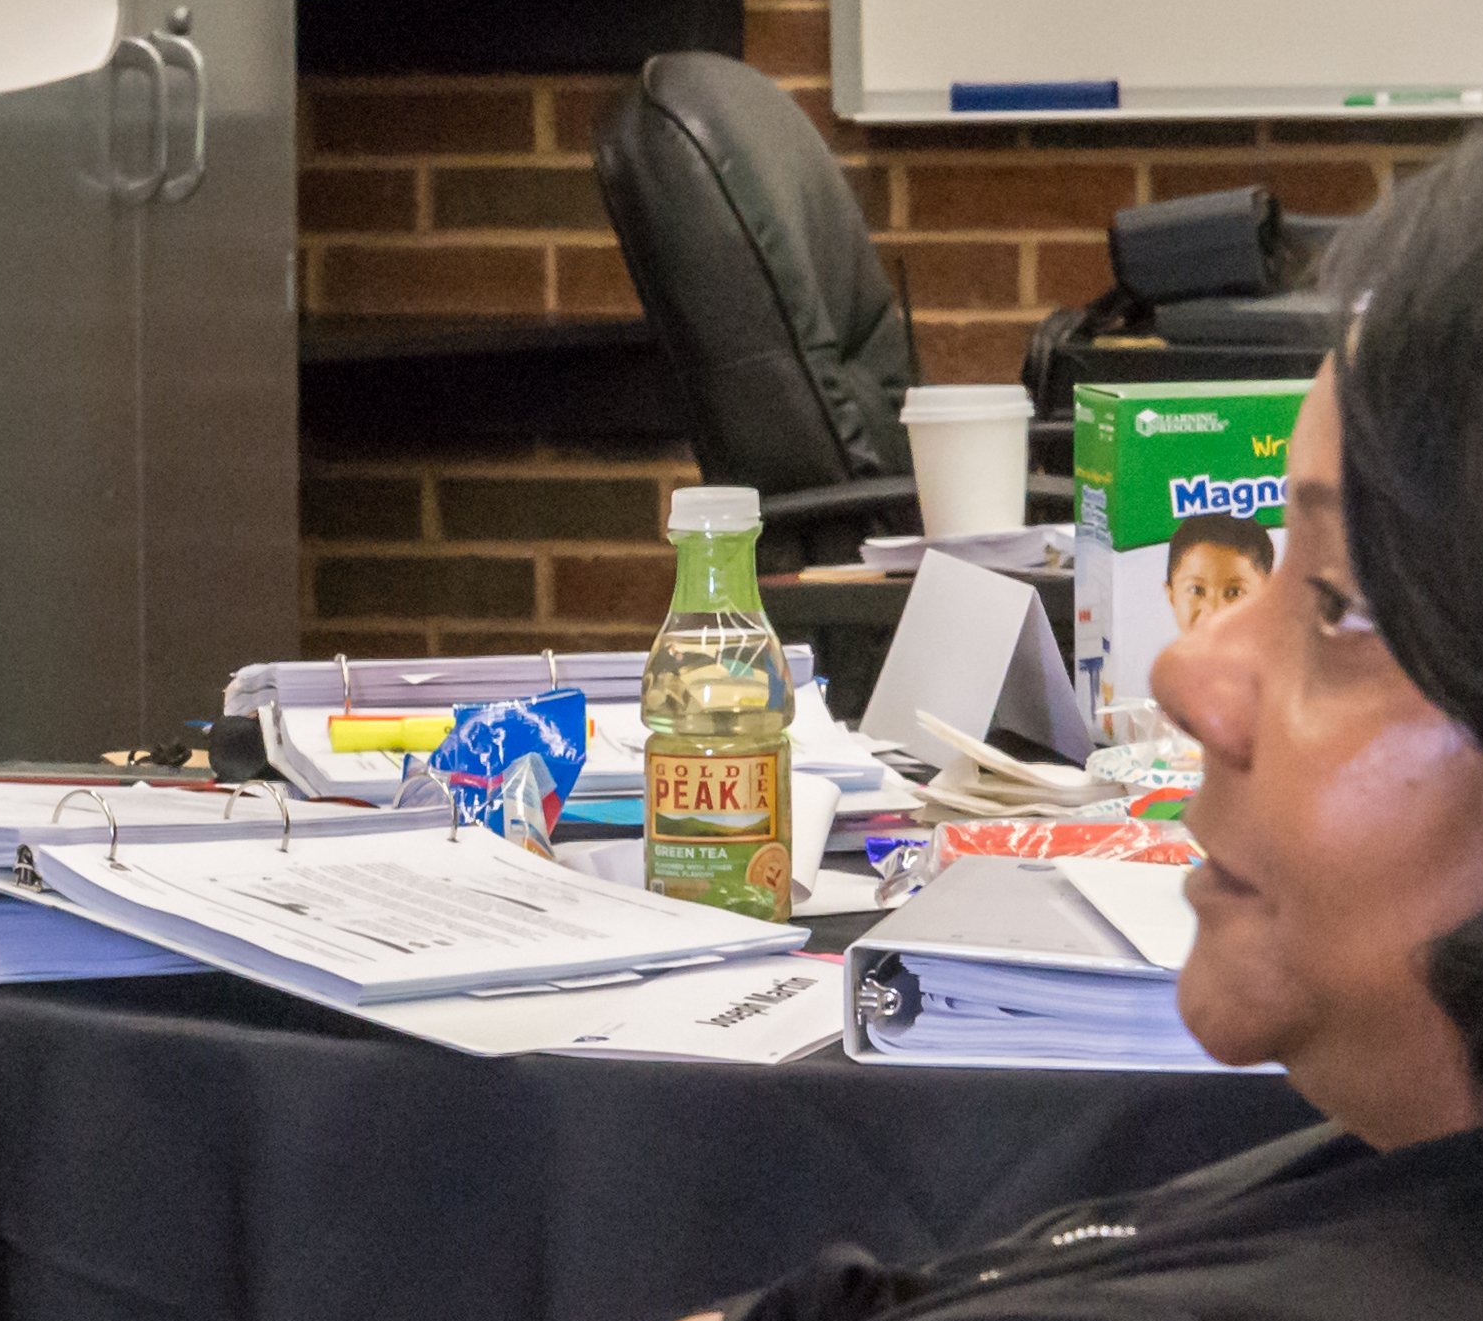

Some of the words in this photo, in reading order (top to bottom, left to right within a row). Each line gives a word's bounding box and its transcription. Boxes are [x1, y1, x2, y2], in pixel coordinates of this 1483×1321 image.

[655, 763, 740, 778] GOLD
[655, 779, 741, 810] PEAK
[756, 762, 769, 809] TEA
[654, 845, 694, 859] GREEN
[699, 847, 728, 859] TEA
